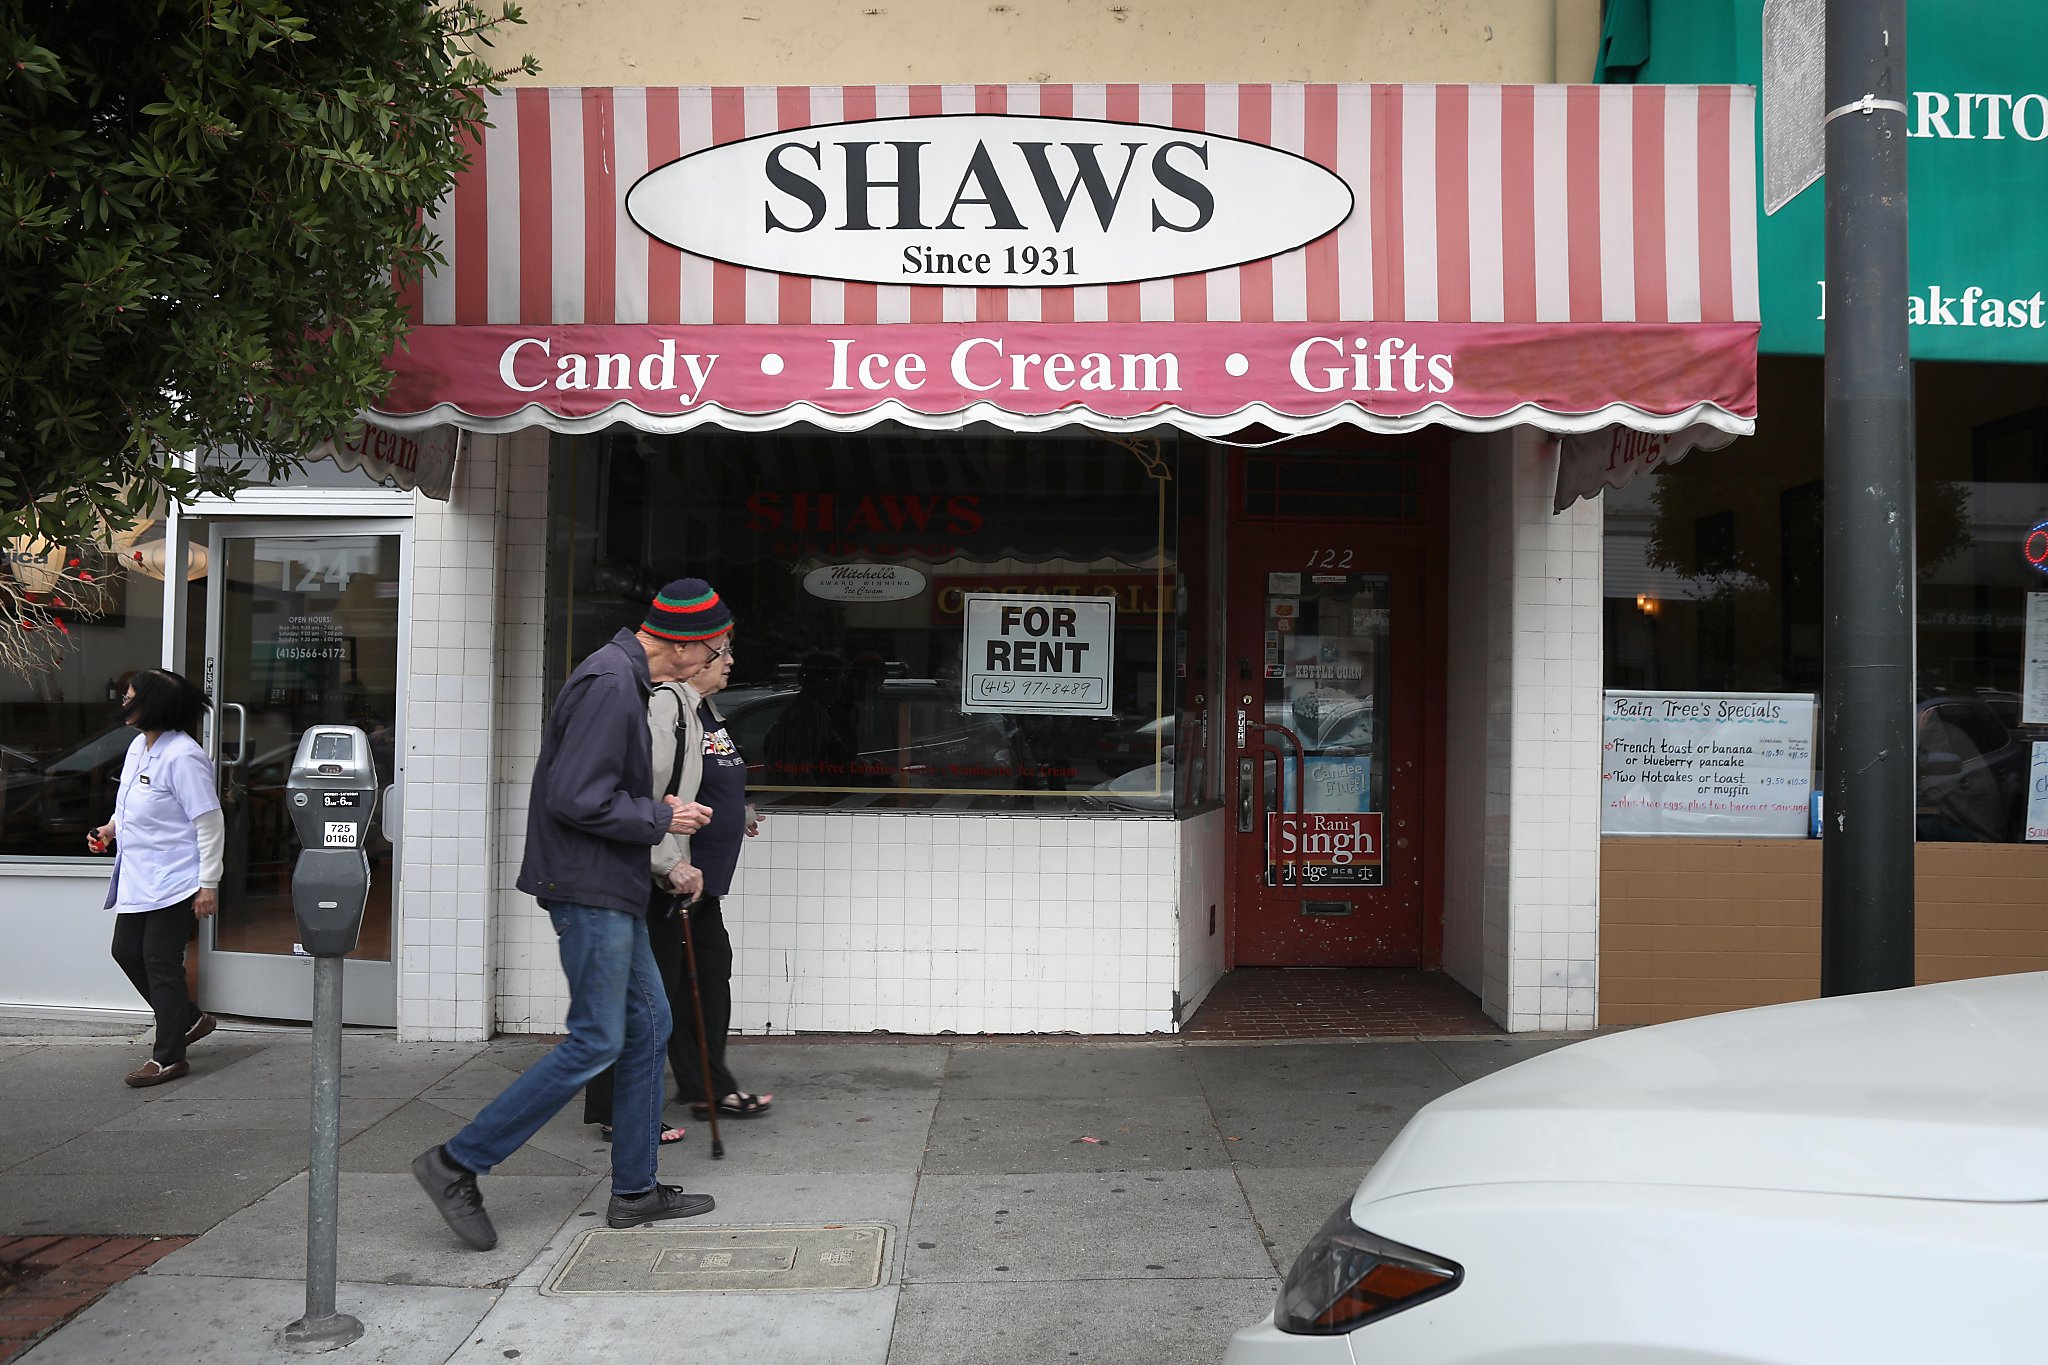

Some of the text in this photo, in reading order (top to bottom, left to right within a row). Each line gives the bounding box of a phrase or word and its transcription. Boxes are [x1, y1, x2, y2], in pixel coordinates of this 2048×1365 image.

[1906, 91, 2048, 142] RITO
[765, 138, 1214, 235] SHAWS
[902, 245, 1080, 277] Since 1931
[1817, 280, 2046, 329] akfast
[499, 335, 1455, 406] Candy Ice Cream Gifts
[745, 491, 985, 535] SHAWS
[1305, 547, 1354, 569] 122
[281, 551, 350, 592] 124
[831, 566, 896, 580] Mitchell's
[844, 586, 883, 595] Ice Cream
[1000, 605, 1077, 638] FOR
[276, 647, 346, 660] (415)566-6172
[986, 640, 1090, 673] RENT
[1295, 664, 1363, 680] KETTLE CORN
[980, 678, 1091, 698] (415) 971-8489
[1612, 698, 1781, 720] Rain Tree's Specials
[1613, 738, 1656, 753] French
[1660, 740, 1693, 754] toast
[1697, 745, 1710, 754] or
[1712, 740, 1753, 754] banana
[1643, 754, 1693, 768] blueberry
[1700, 755, 1745, 768] pancake
[1312, 763, 1363, 783] Candee
[1613, 770, 1636, 783] Two
[1641, 770, 1693, 783] Hotcakes
[1698, 775, 1711, 783] or
[1714, 772, 1745, 784] toast
[1697, 785, 1749, 798] or muffin
[331, 824, 351, 833] 725
[1314, 815, 1350, 831] Rani
[326, 834, 355, 843] 01160
[1282, 820, 1375, 865] Singh
